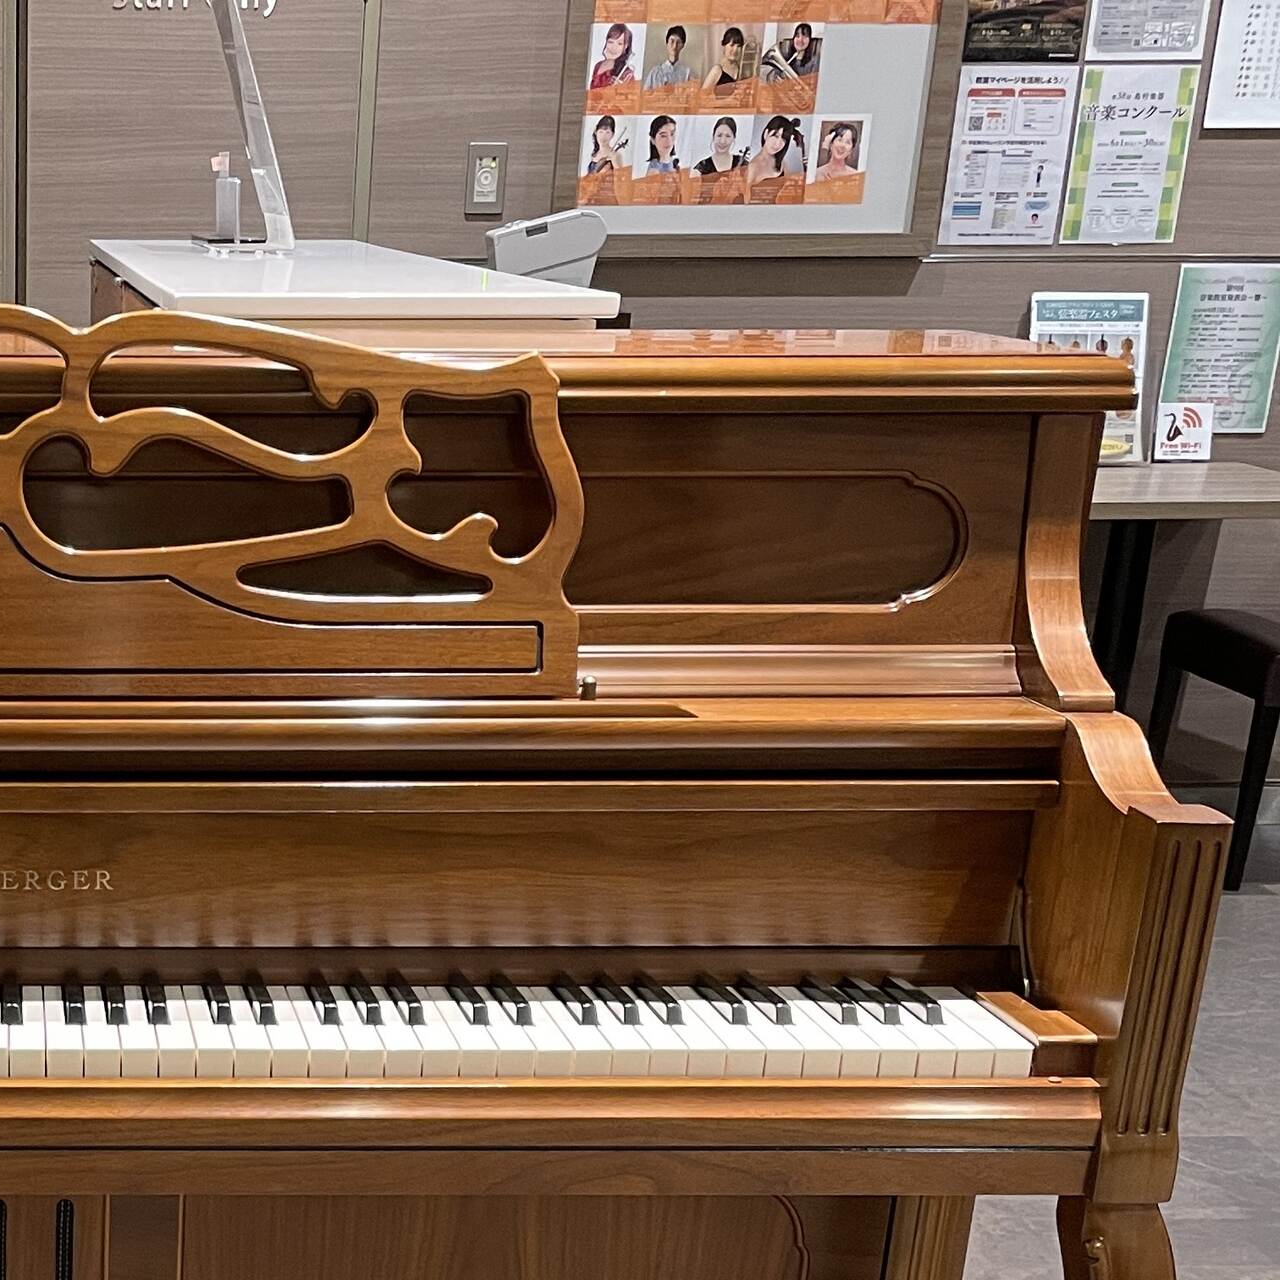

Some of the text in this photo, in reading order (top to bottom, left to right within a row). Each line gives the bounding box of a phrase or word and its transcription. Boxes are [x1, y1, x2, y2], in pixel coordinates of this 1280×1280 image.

[1086, 104, 1187, 121] 音楽コンクール
